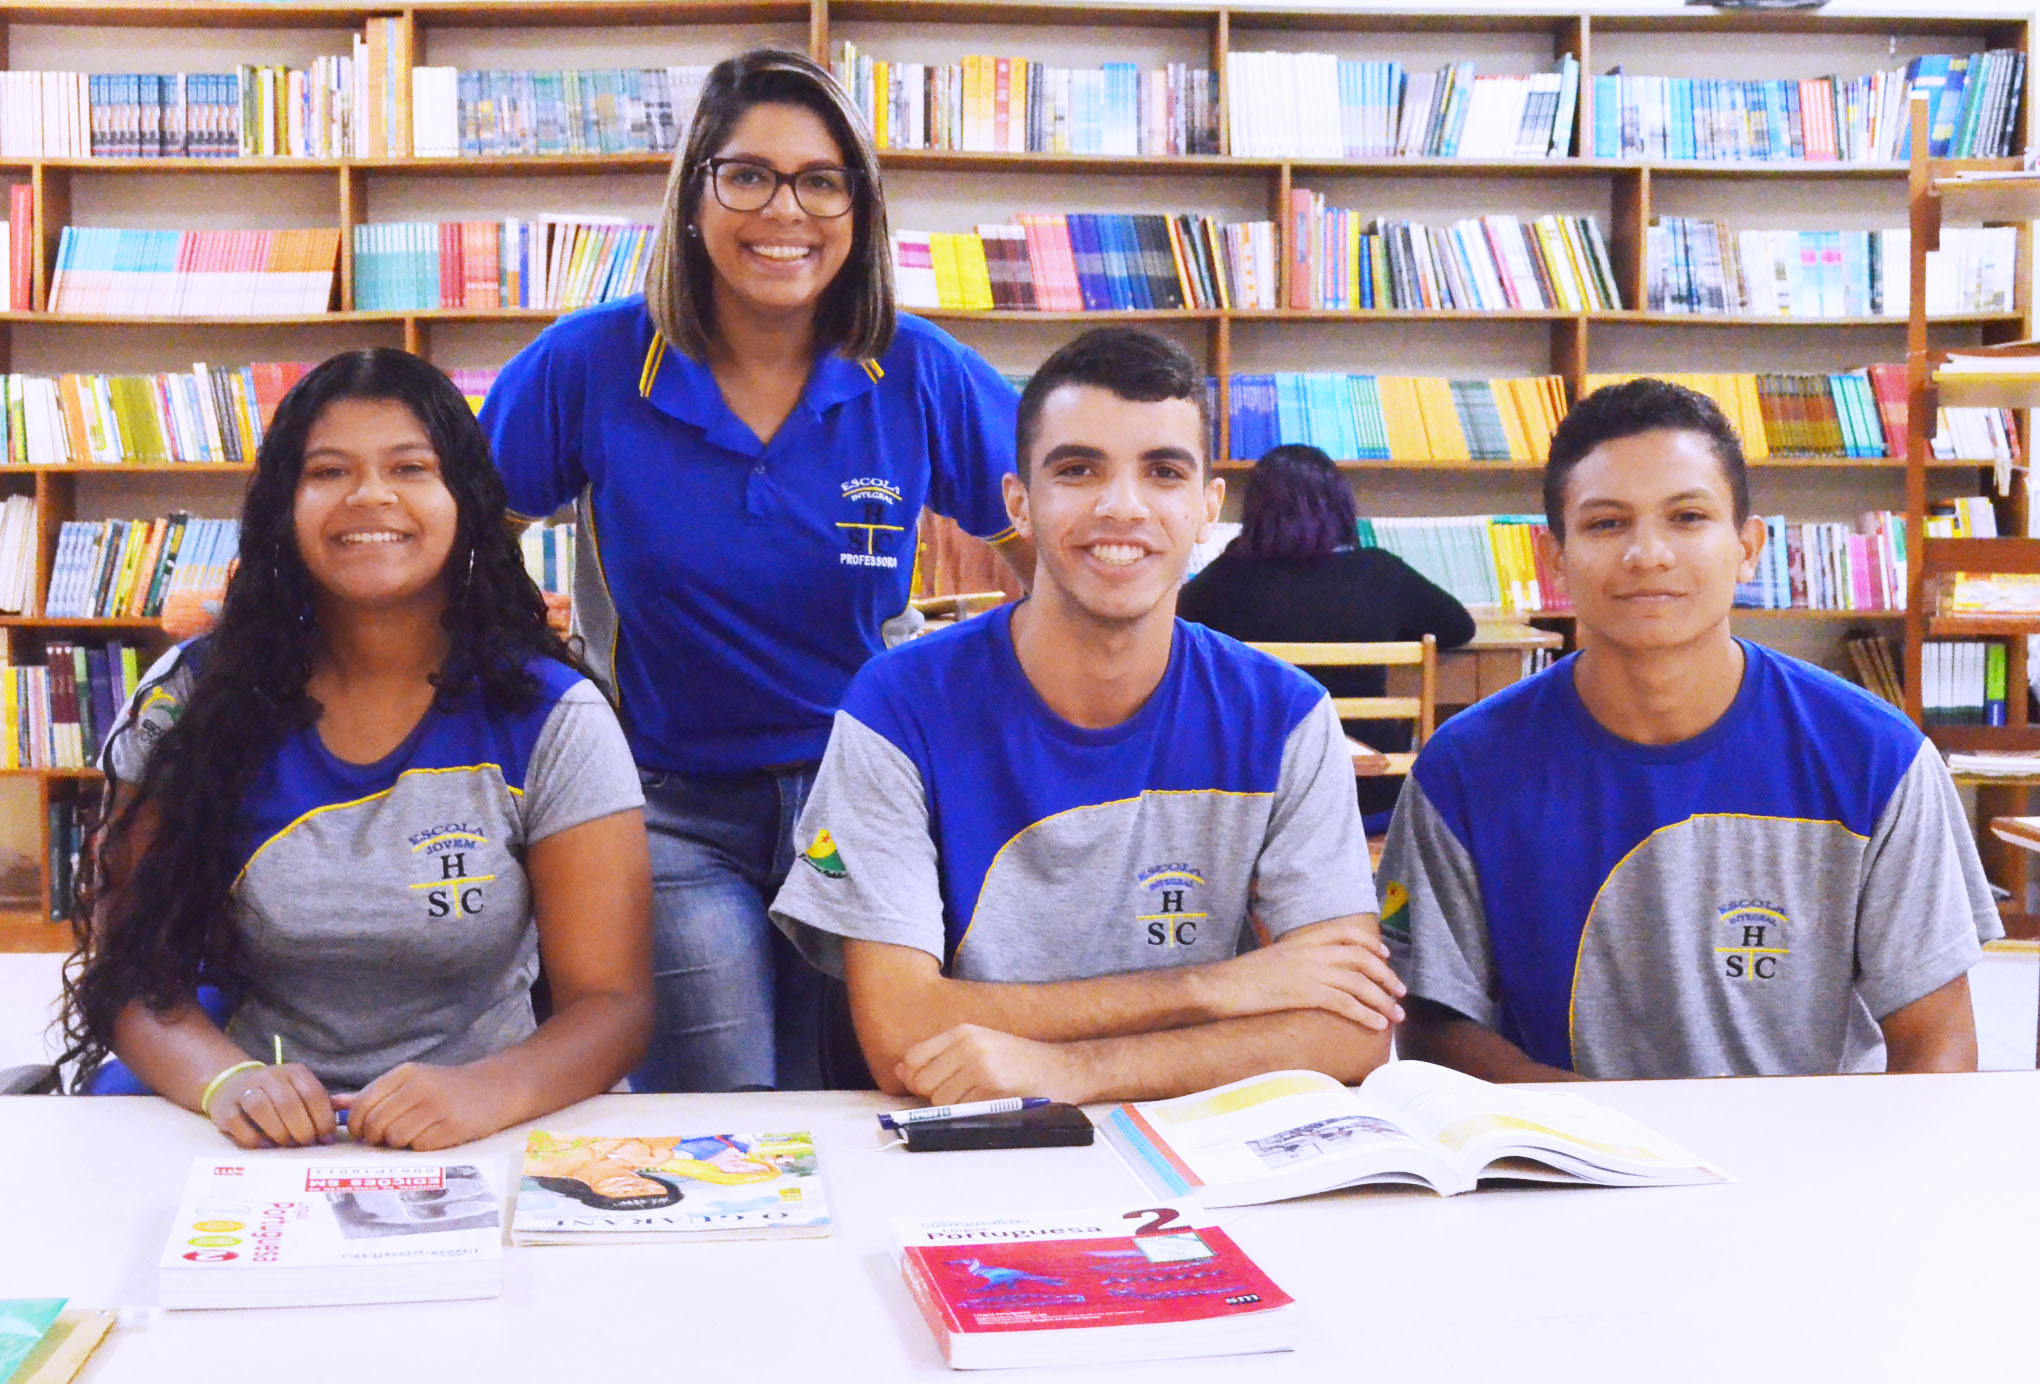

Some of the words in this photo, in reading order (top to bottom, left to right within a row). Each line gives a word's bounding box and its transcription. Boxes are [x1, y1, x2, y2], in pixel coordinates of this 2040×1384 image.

[840, 477, 901, 495] ESCOLA
[850, 491, 894, 505] INTEGRAL
[840, 553, 898, 568] PROFESSORA
[408, 823, 485, 845] ESCOLA
[426, 839, 477, 855] JOVEM
[440, 852, 467, 880] H
[1137, 862, 1202, 881] ESCOLA
[428, 890, 450, 917] S
[461, 887, 484, 914] C
[1161, 890, 1184, 912] H
[1718, 899, 1786, 917] ESCOLA
[1148, 922, 1166, 945] S
[1175, 921, 1197, 945] C
[1742, 925, 1766, 946] H
[1726, 954, 1743, 977] S
[1755, 956, 1777, 979] C
[1122, 1207, 1194, 1235] 2
[251, 1202, 295, 1263] Portuguesa
[927, 1225, 1102, 1241] Portuguesa
[1225, 1293, 1262, 1305] sm
